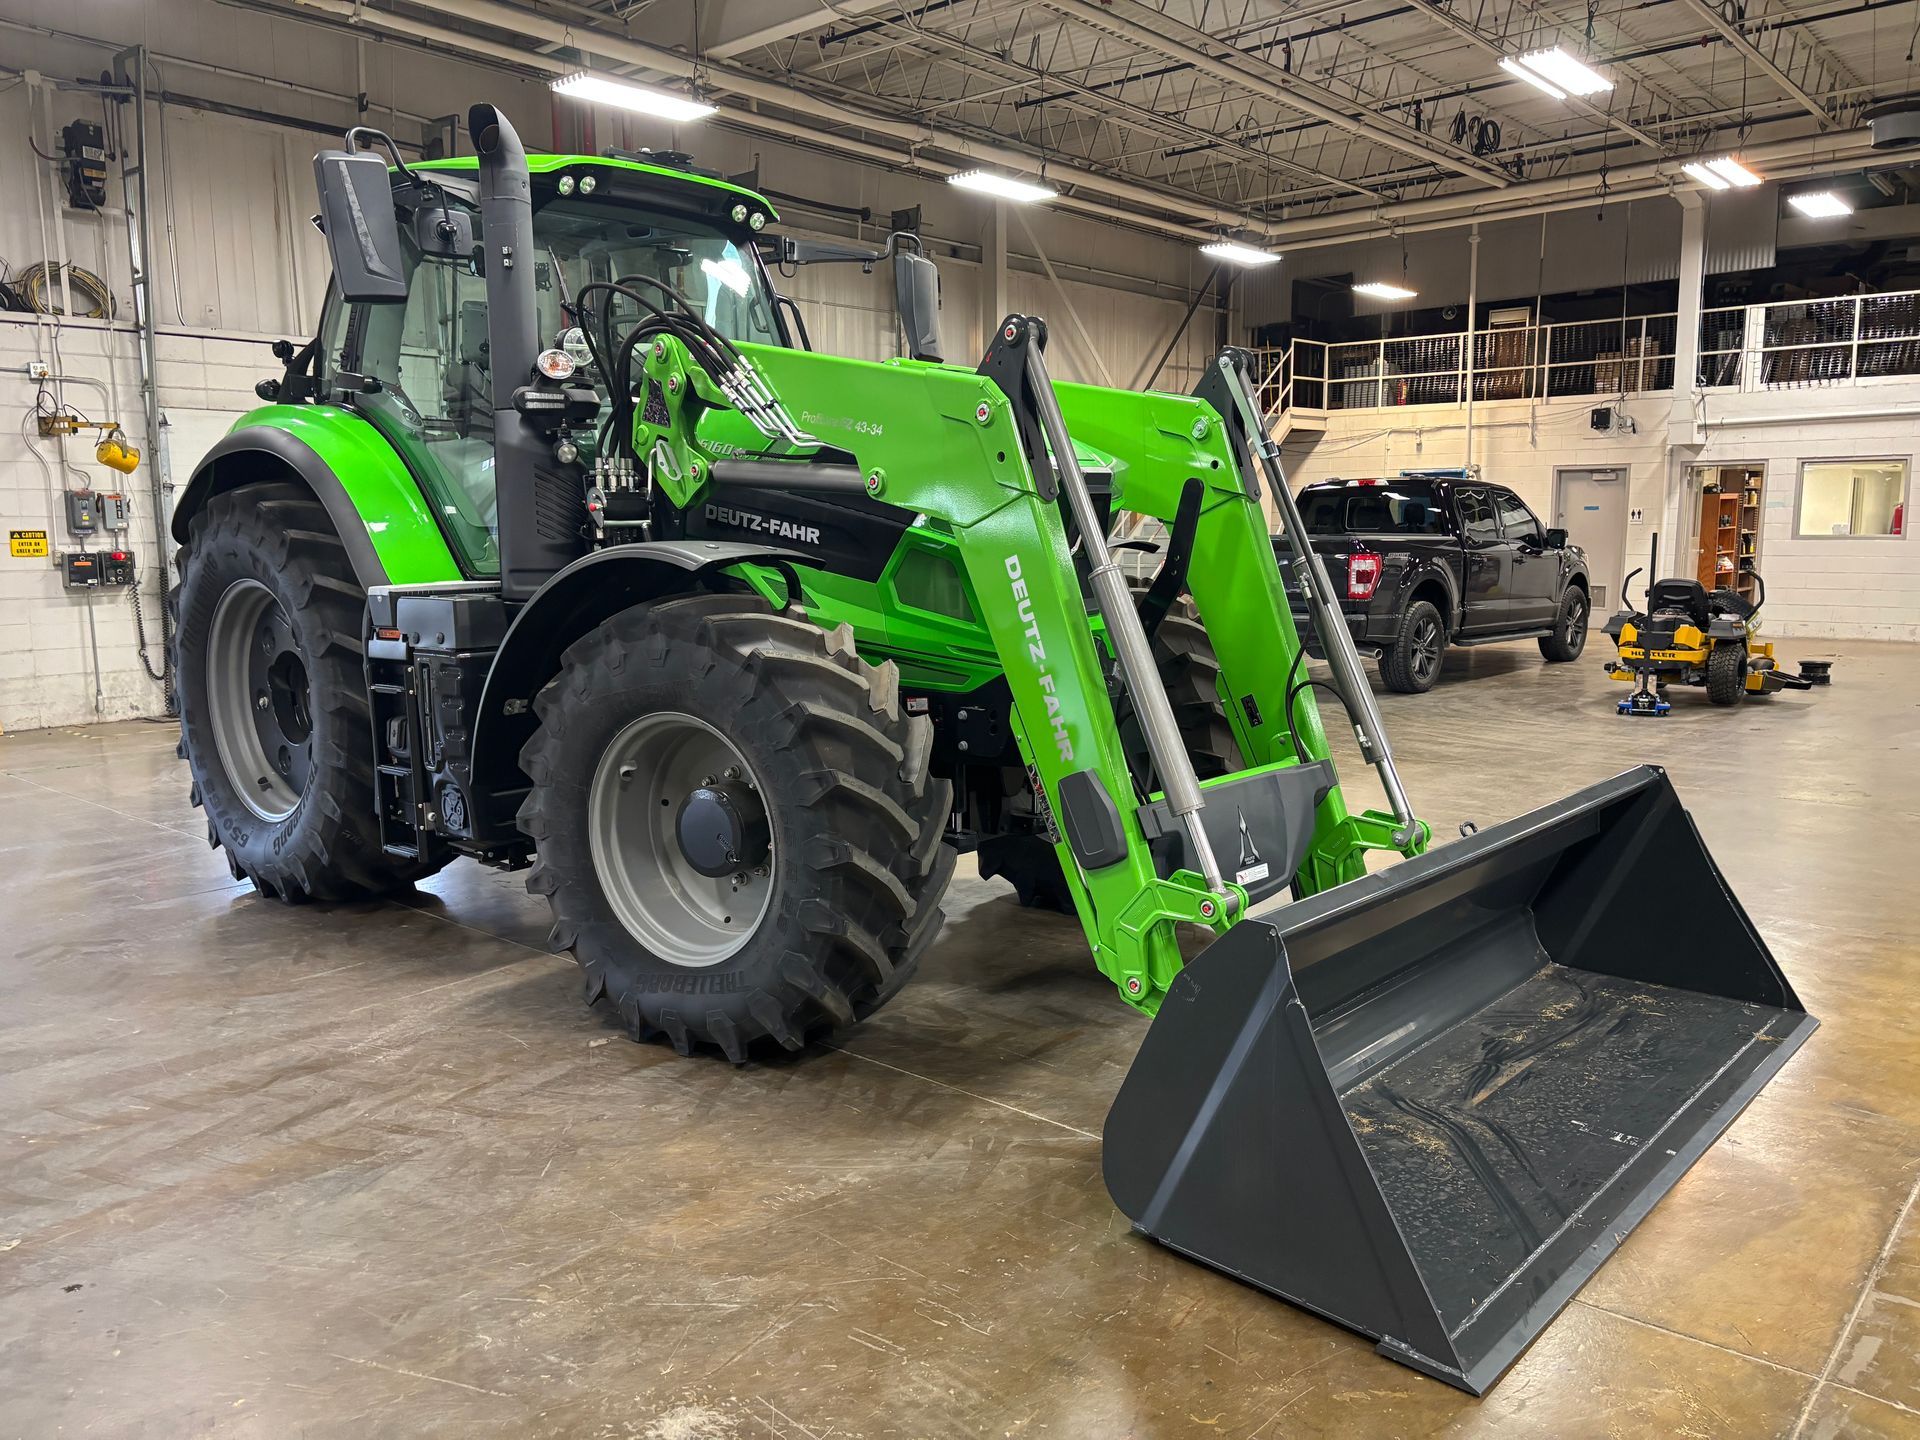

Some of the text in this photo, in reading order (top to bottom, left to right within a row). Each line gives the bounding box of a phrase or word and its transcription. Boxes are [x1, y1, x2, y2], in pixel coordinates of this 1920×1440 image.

[855, 421, 883, 436] 43-34
[705, 503, 820, 545] DEUTZ-FAHR
[1005, 554, 1074, 763] DEUTZ-FAHR
